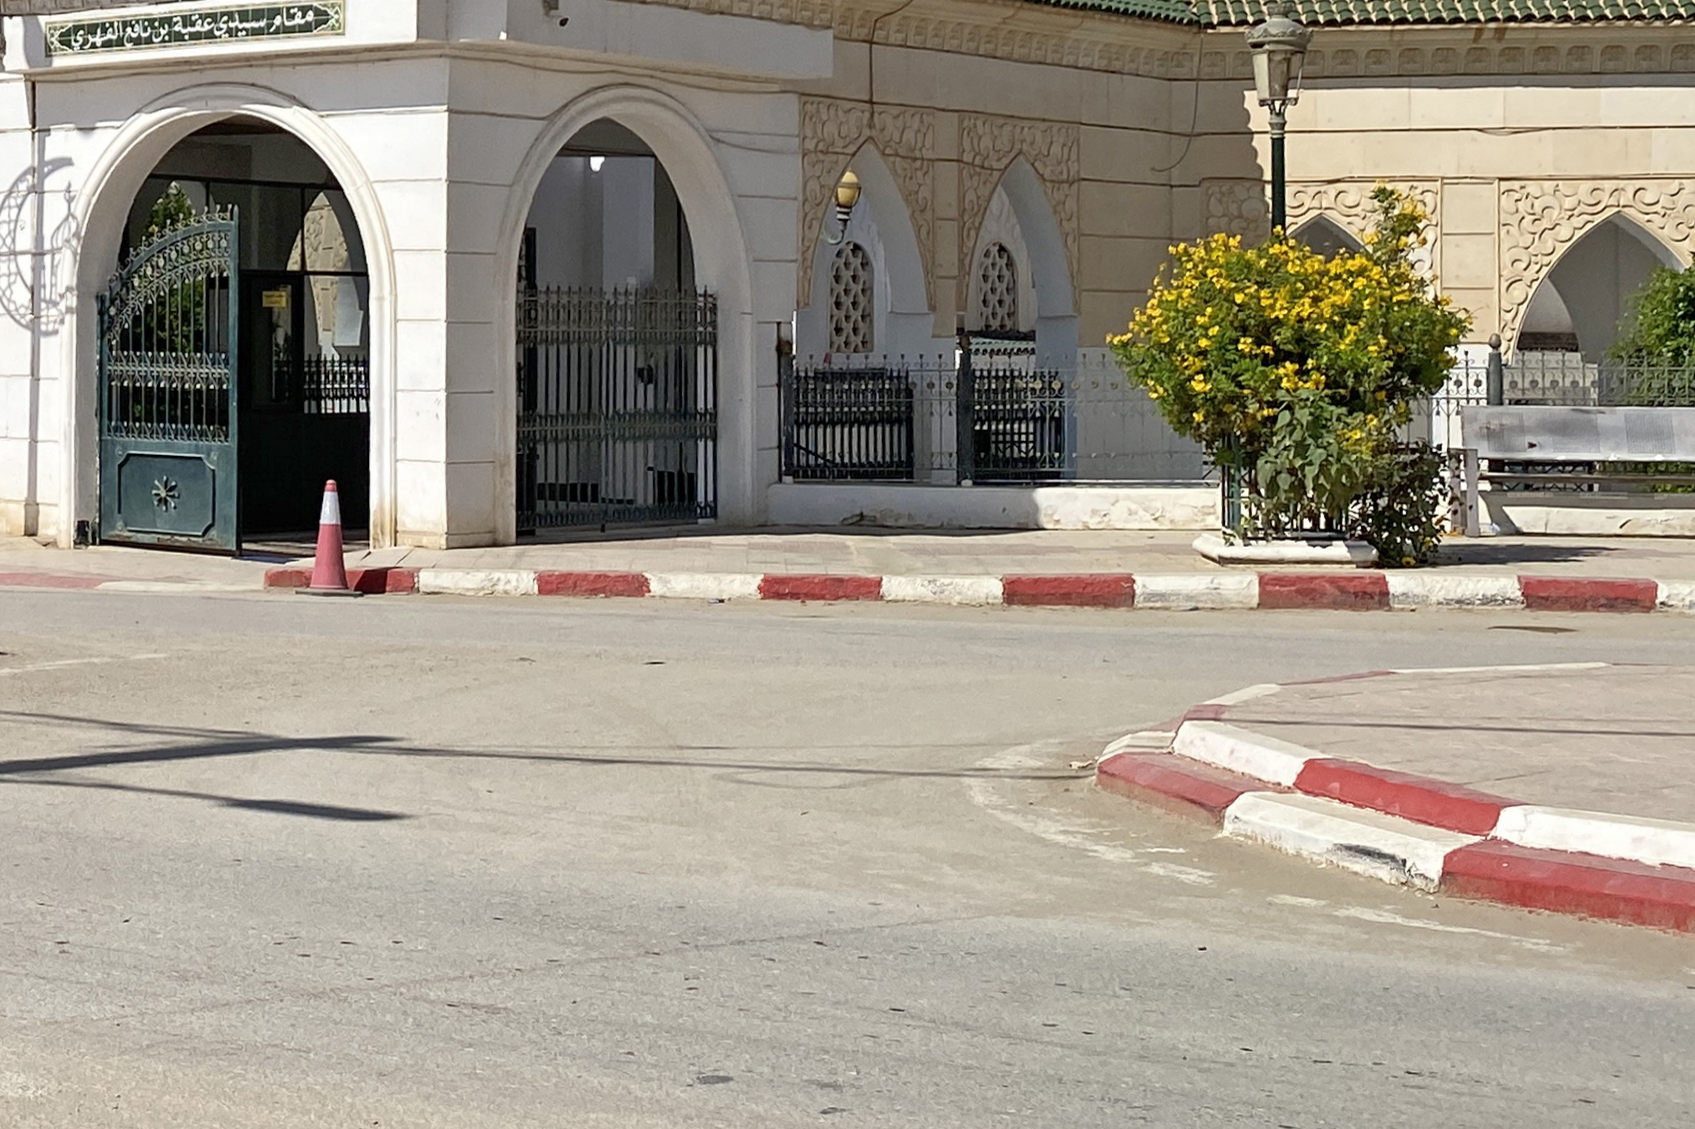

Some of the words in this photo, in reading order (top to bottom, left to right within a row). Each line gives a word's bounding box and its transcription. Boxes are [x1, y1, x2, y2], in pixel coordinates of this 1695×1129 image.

[152, 21, 169, 42] بن
[172, 14, 215, 40] عقبة
[214, 12, 267, 38] سيدي
[269, 6, 315, 32] مقام
[71, 20, 123, 50] الفهري
[124, 19, 151, 47] نافع
